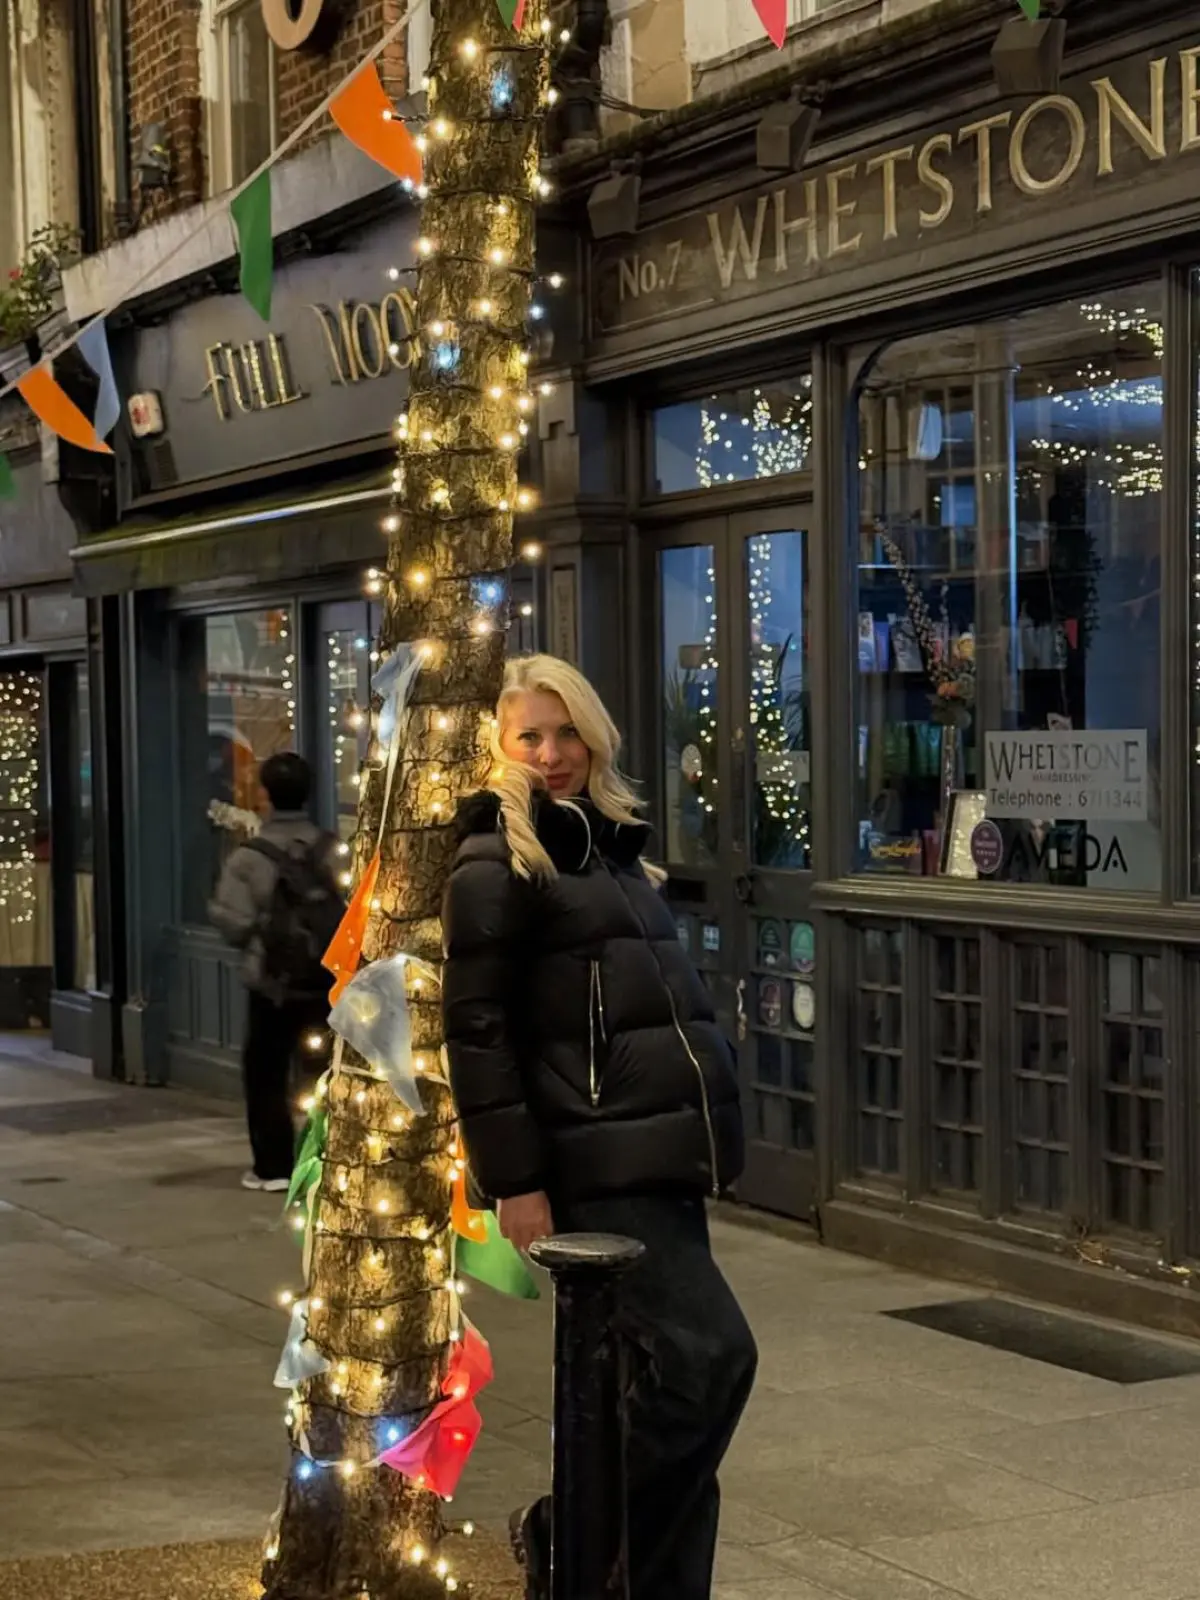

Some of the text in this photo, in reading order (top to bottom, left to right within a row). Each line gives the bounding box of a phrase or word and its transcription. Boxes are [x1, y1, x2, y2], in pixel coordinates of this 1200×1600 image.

[707, 46, 1200, 288] WHETSTONE
[201, 332, 306, 421] FULL
[990, 741, 1141, 783] WHETSTONE
[989, 788, 1062, 809] Telephone
[1008, 835, 1128, 873] AVEDA
